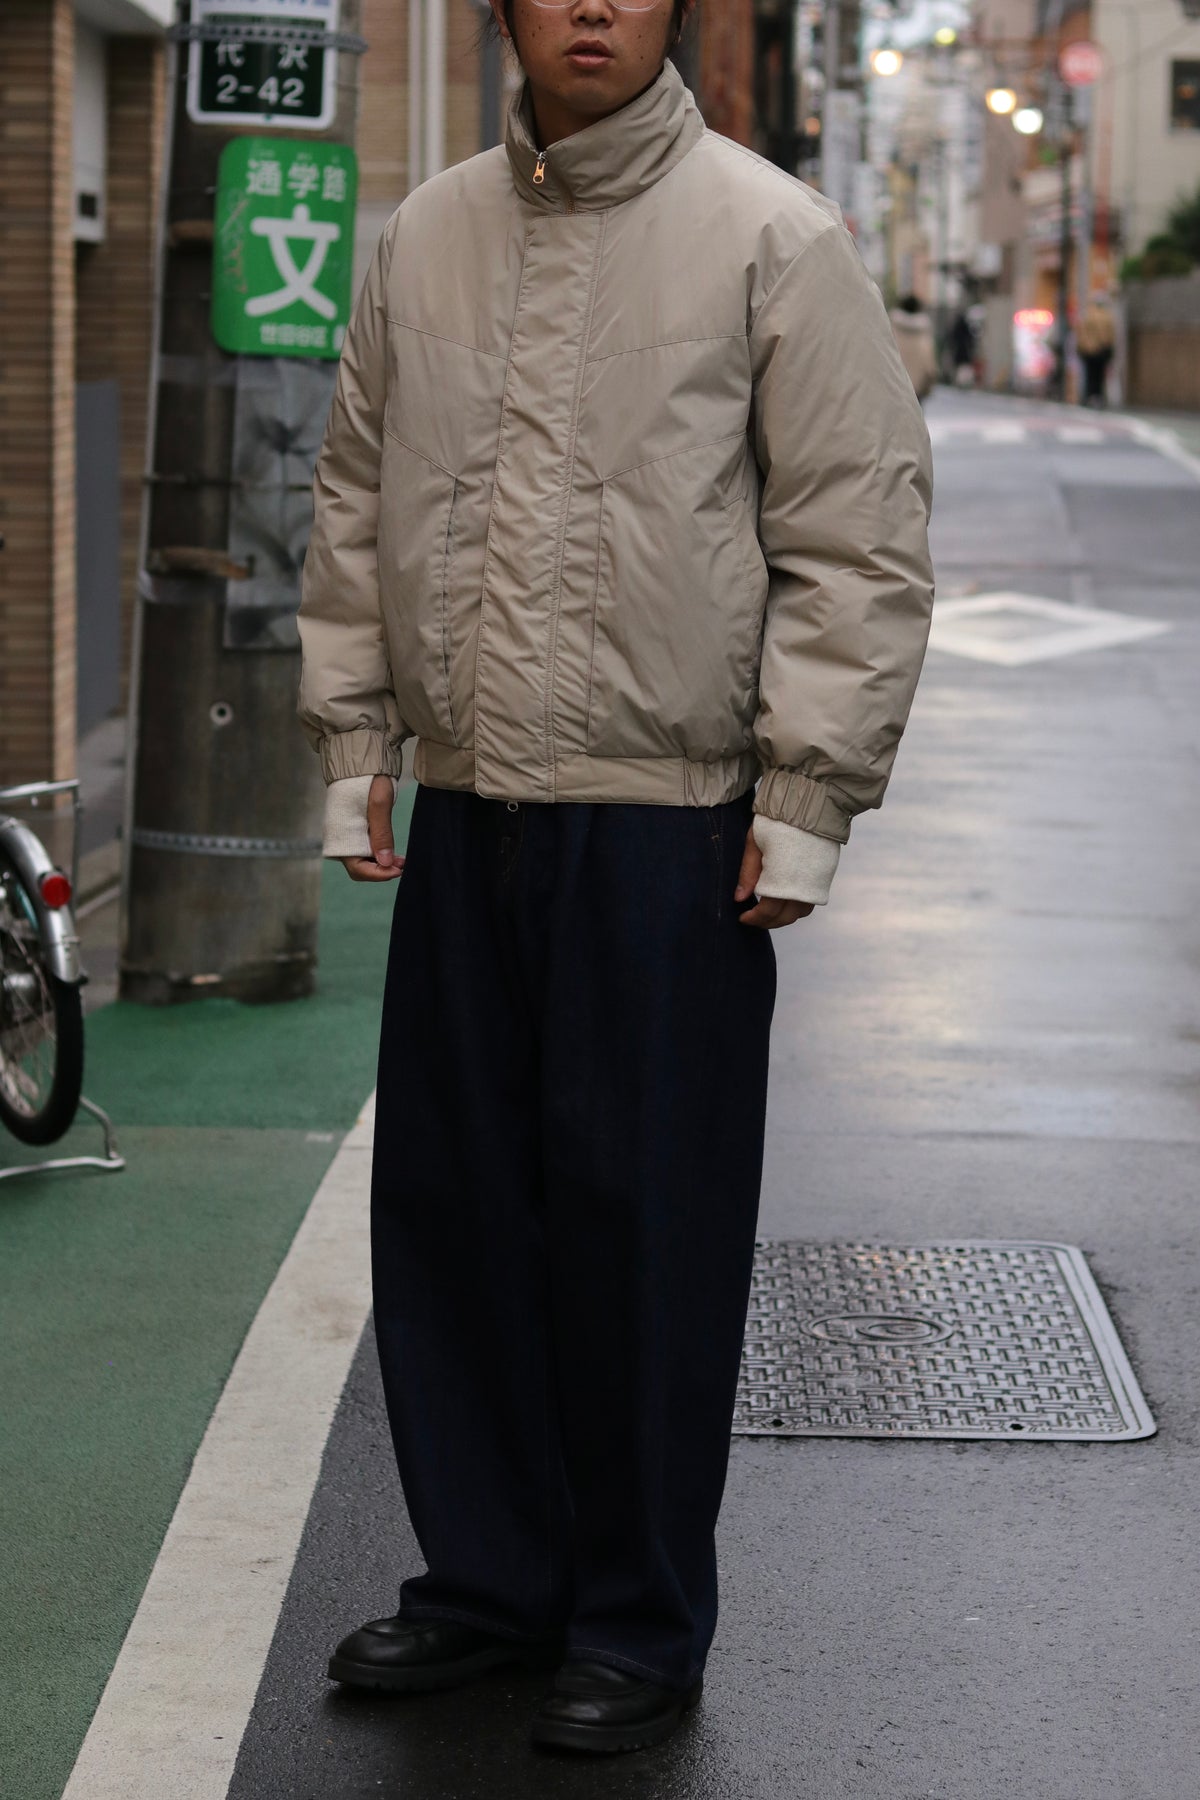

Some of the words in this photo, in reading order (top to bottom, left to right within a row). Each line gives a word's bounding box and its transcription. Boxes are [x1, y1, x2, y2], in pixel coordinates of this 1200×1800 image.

[216, 76, 305, 107] 2-42
[245, 159, 347, 203] 通学路
[244, 203, 340, 320] 文
